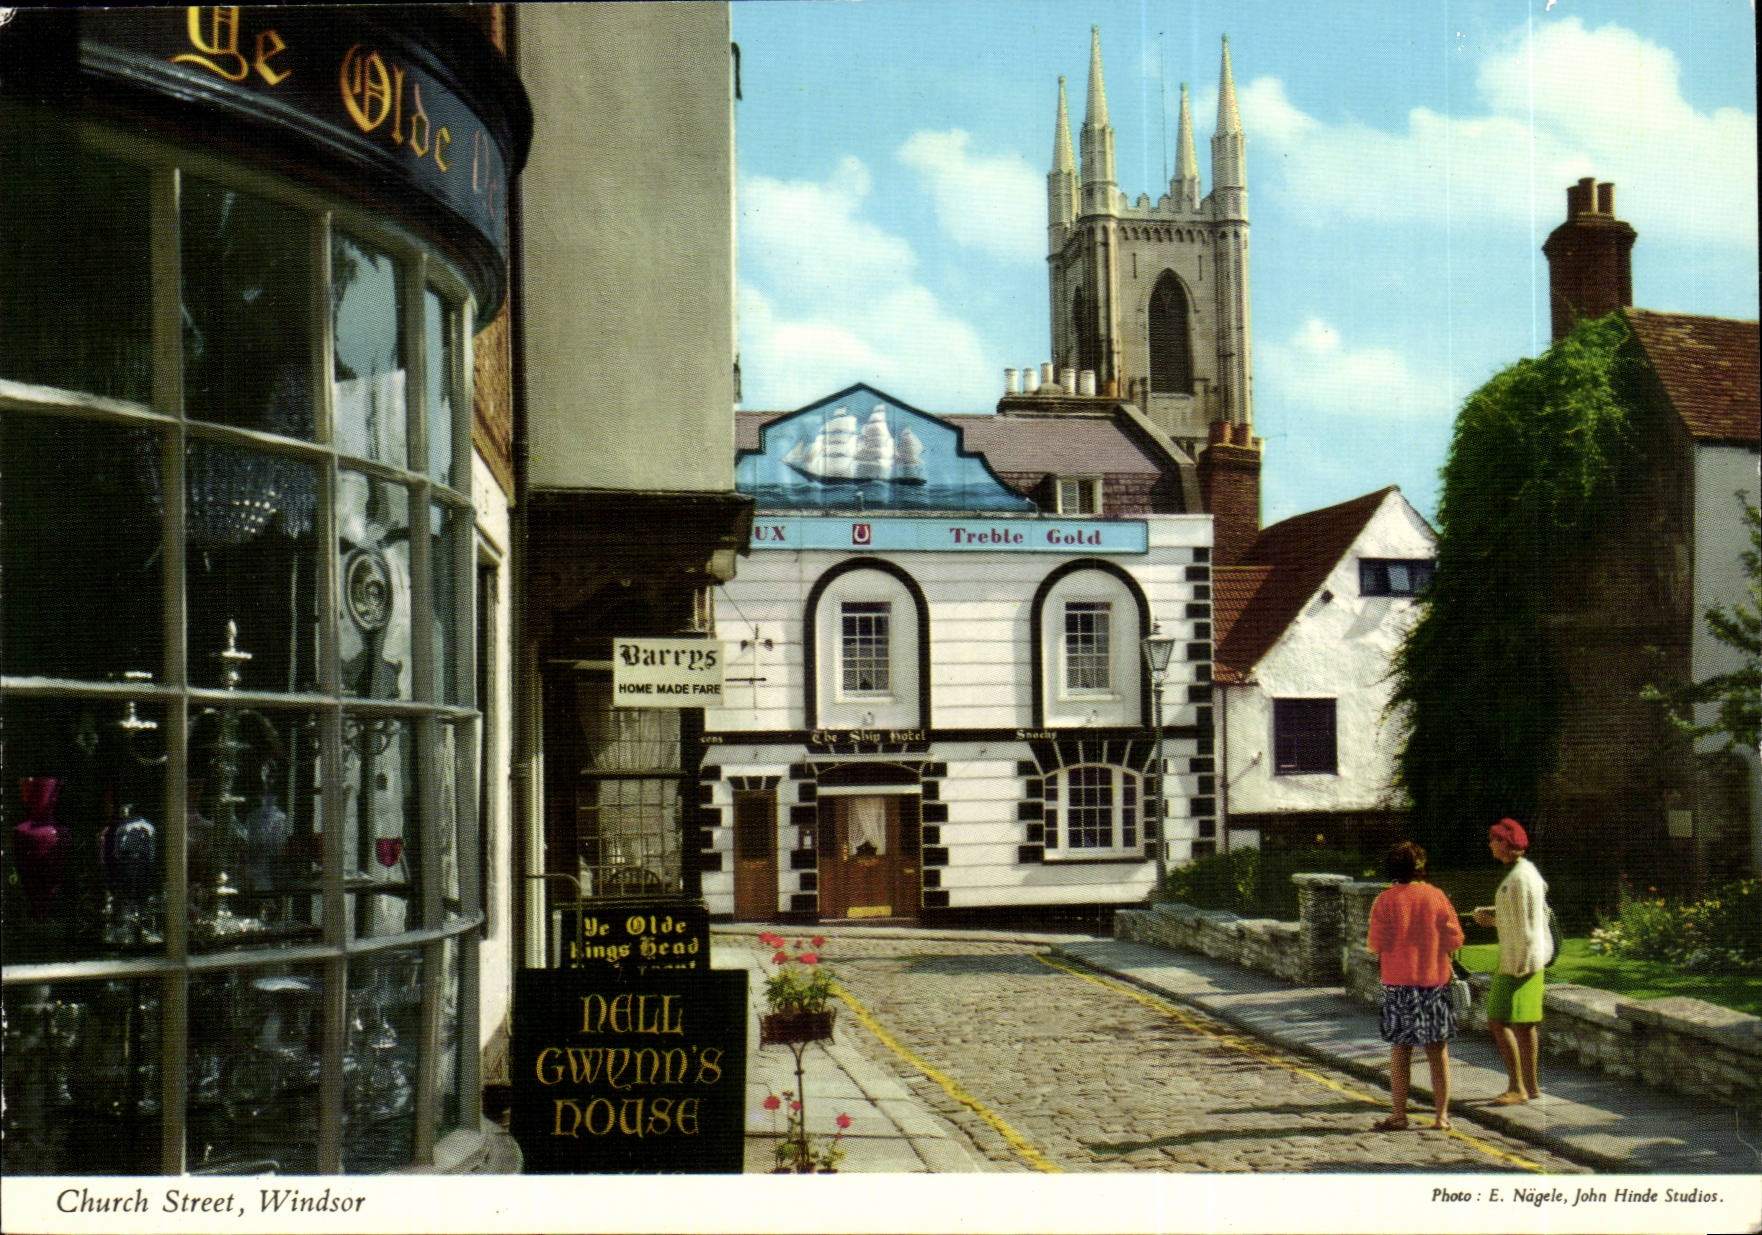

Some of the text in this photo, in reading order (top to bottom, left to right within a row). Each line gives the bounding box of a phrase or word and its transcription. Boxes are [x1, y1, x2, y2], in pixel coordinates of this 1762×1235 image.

[340, 44, 453, 172] Olde
[754, 525, 1102, 545] UX Treble Gold
[619, 644, 717, 671] Barrys
[619, 683, 721, 695] HOME MADE FARE
[811, 728, 927, 744] The Ship Hotel
[584, 915, 687, 937] Ye Olde
[639, 935, 699, 960] Head
[580, 993, 684, 1036] NELL
[536, 1045, 725, 1091] GWYNN'S
[551, 1098, 701, 1139] HOUSE
